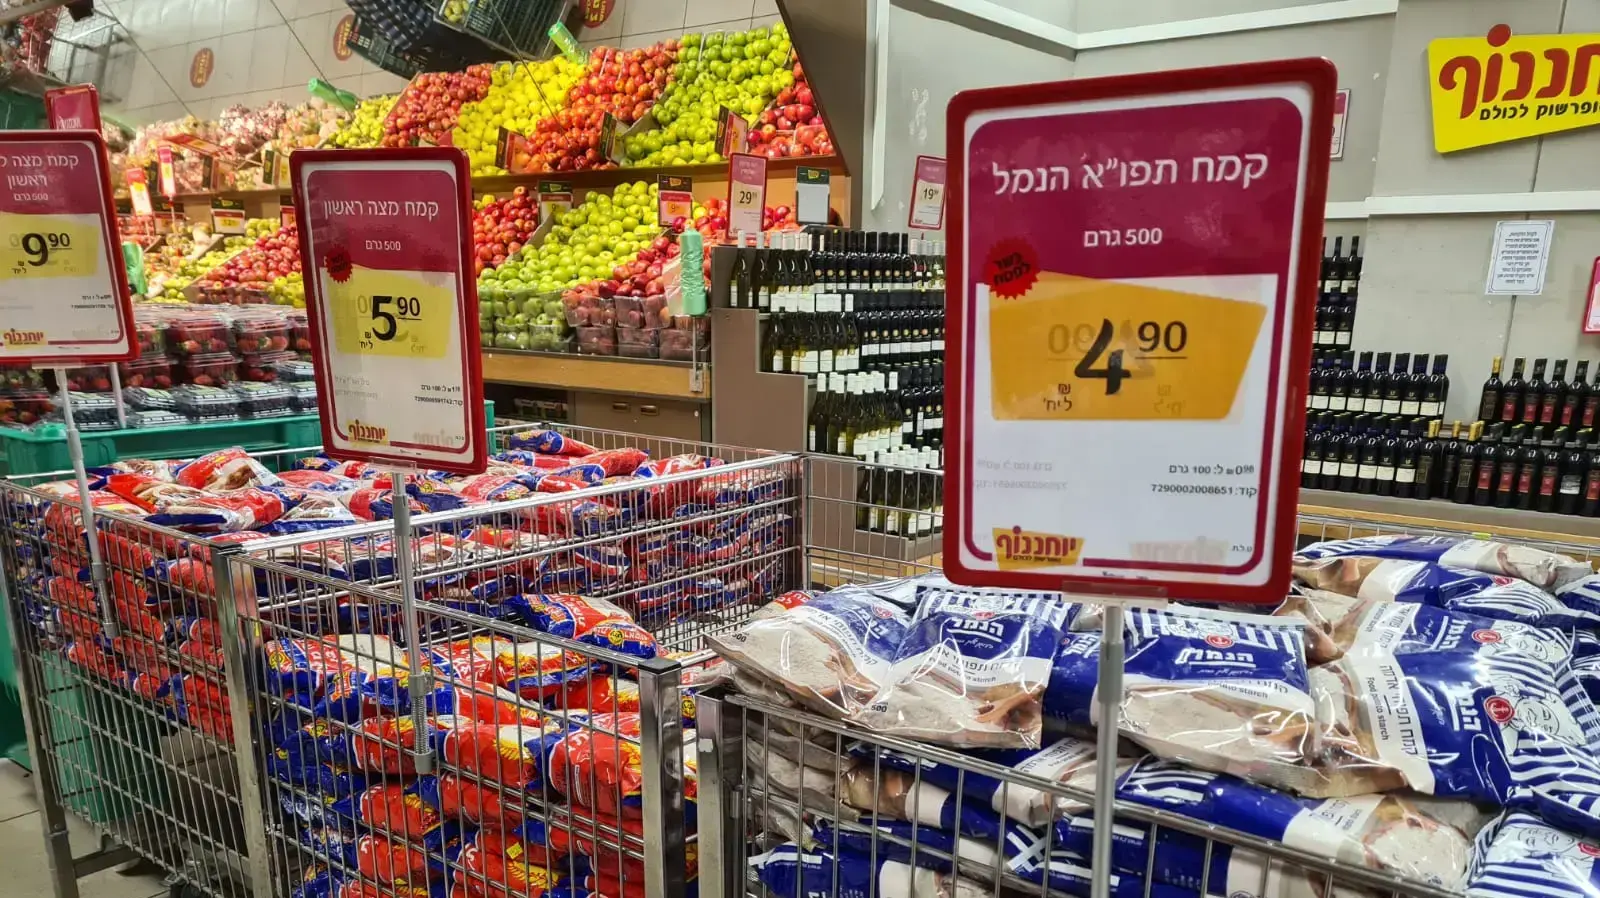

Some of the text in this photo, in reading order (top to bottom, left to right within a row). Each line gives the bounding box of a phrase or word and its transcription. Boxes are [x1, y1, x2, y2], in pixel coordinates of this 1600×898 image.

[1480, 104, 1529, 120] לכולם
[11, 155, 42, 168] מצה
[47, 155, 79, 170] קמח
[1192, 153, 1268, 189] קמח
[7, 174, 48, 190] ראשון
[992, 162, 1070, 195] הנמל
[14, 193, 48, 201] 500 גרם
[323, 200, 439, 222] קמח מצה ראשון
[366, 240, 401, 251] 500 גרם
[1084, 227, 1163, 247] 500 גרם
[348, 419, 386, 441] יוחננוף
[1168, 464, 1189, 474] גרם
[996, 525, 1077, 560] יוחננוף
[950, 617, 1005, 638] הנמל
[1377, 714, 1390, 741] starch
